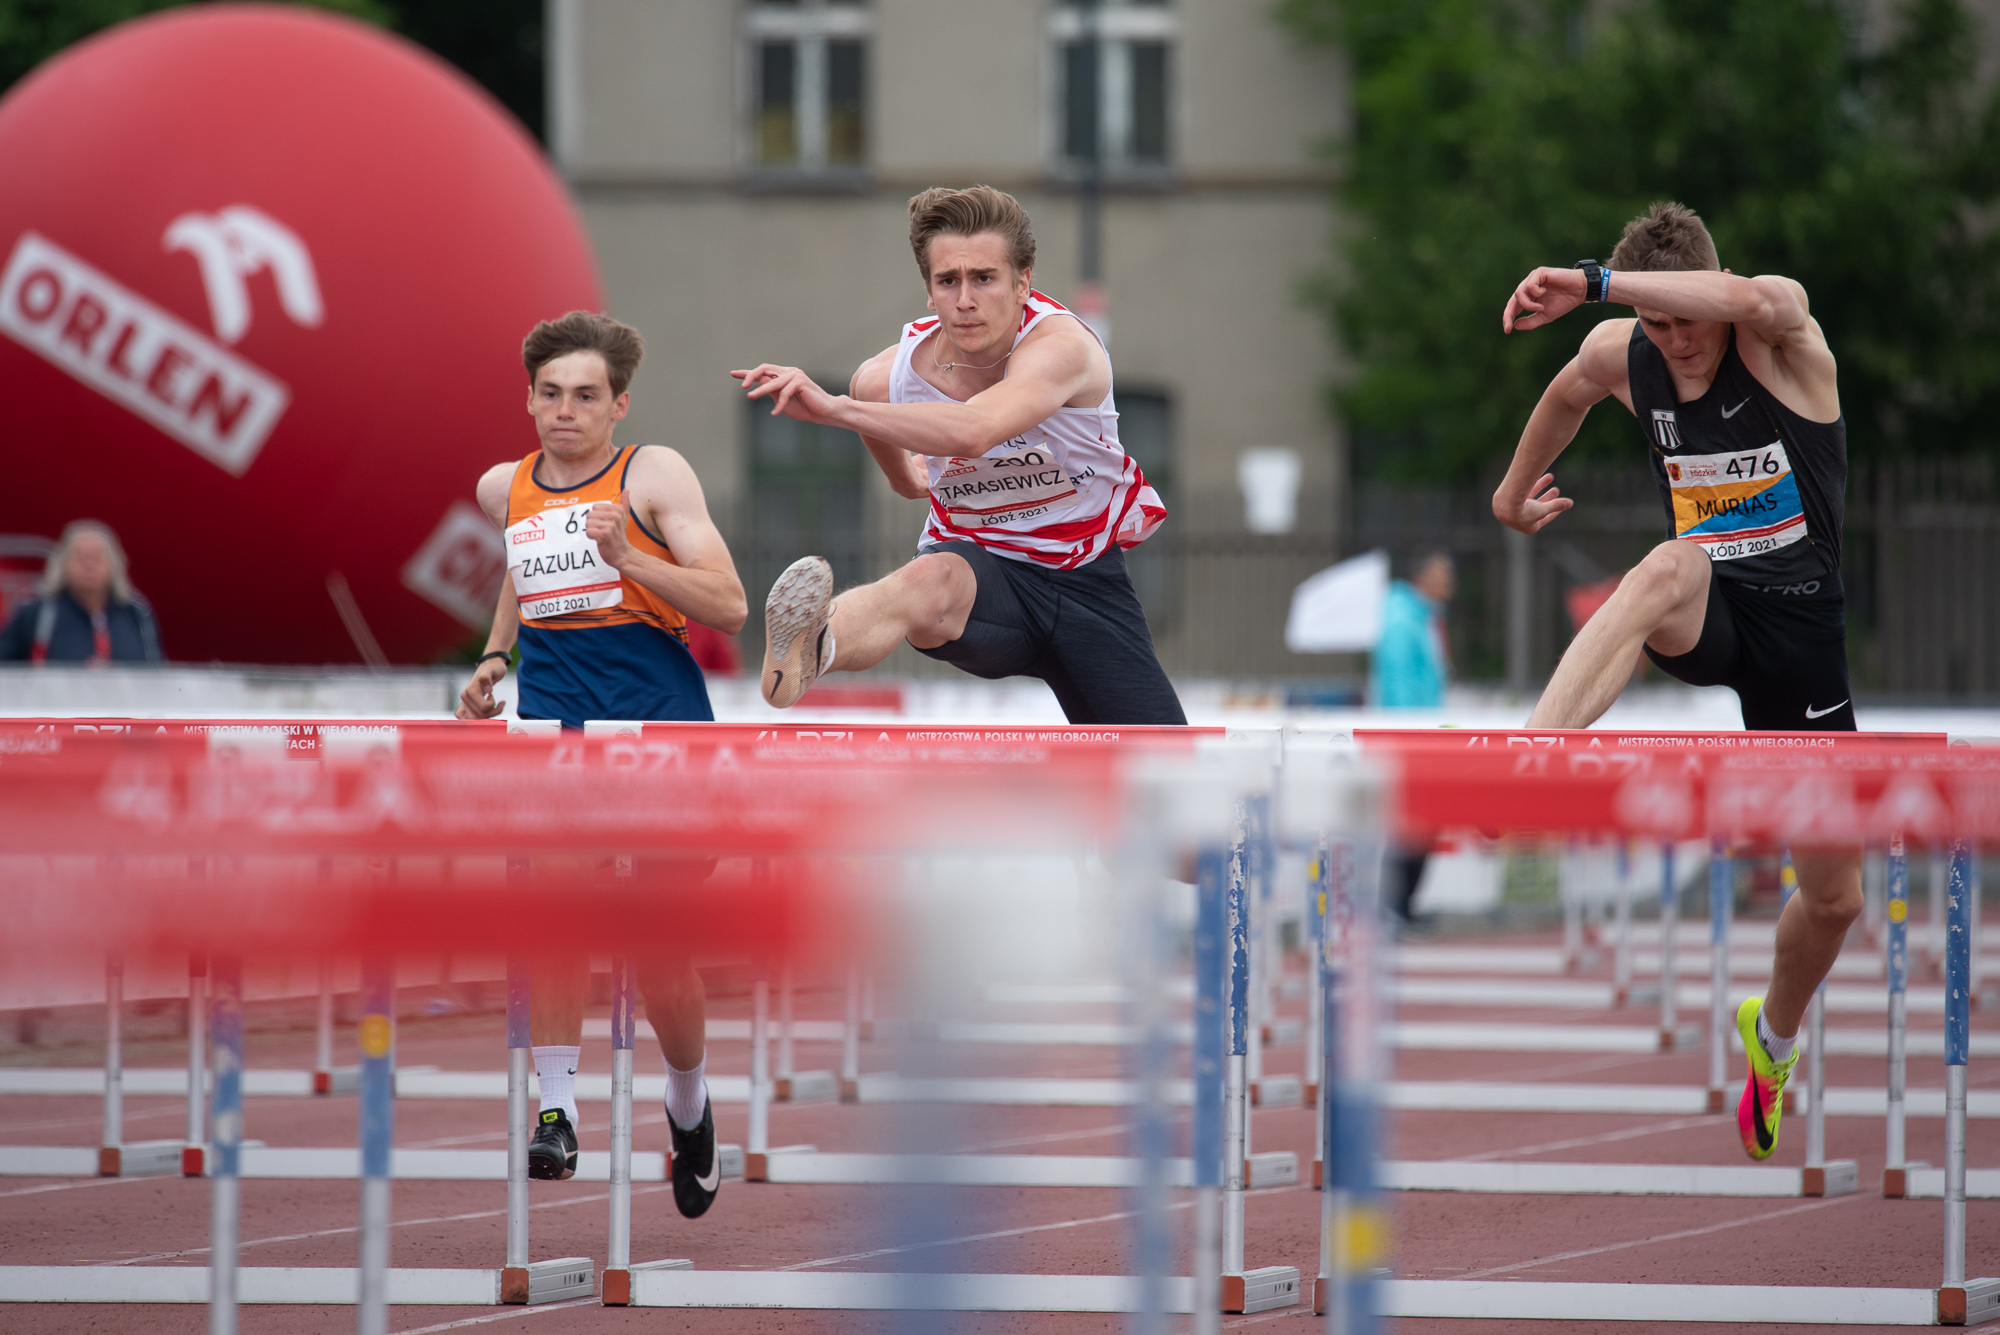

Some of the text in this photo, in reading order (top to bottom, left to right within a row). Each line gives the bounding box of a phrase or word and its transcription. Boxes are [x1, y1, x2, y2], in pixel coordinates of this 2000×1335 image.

[17, 268, 252, 438] ORLEN
[988, 452, 1045, 468] 200
[1726, 451, 1780, 479] 476
[939, 469, 1065, 500] TARASIEWICZ
[981, 506, 1049, 526] ŁÓDŹ 2021
[1696, 493, 1778, 520] MURIAS
[514, 531, 543, 544] ORLEN
[1709, 538, 1777, 558] ŁÓDŹ 2021
[522, 549, 596, 578] ZAZULA
[563, 596, 591, 611] 2021
[184, 725, 258, 735] MISTRZOSTWA
[263, 726, 300, 735] POLSKI
[302, 726, 314, 735] W
[316, 726, 398, 735] WIELOBOJACH
[906, 731, 981, 742] MISTRZOSTWA
[985, 731, 1023, 742] POLSKI
[1025, 732, 1037, 742] W
[1039, 732, 1120, 743] WIELOBOJACH
[1618, 737, 1694, 748] MISTRZOSTWA
[1698, 737, 1736, 748] POLSKI
[1738, 737, 1750, 748] W
[1752, 738, 1835, 749] WIELOBOJACH
